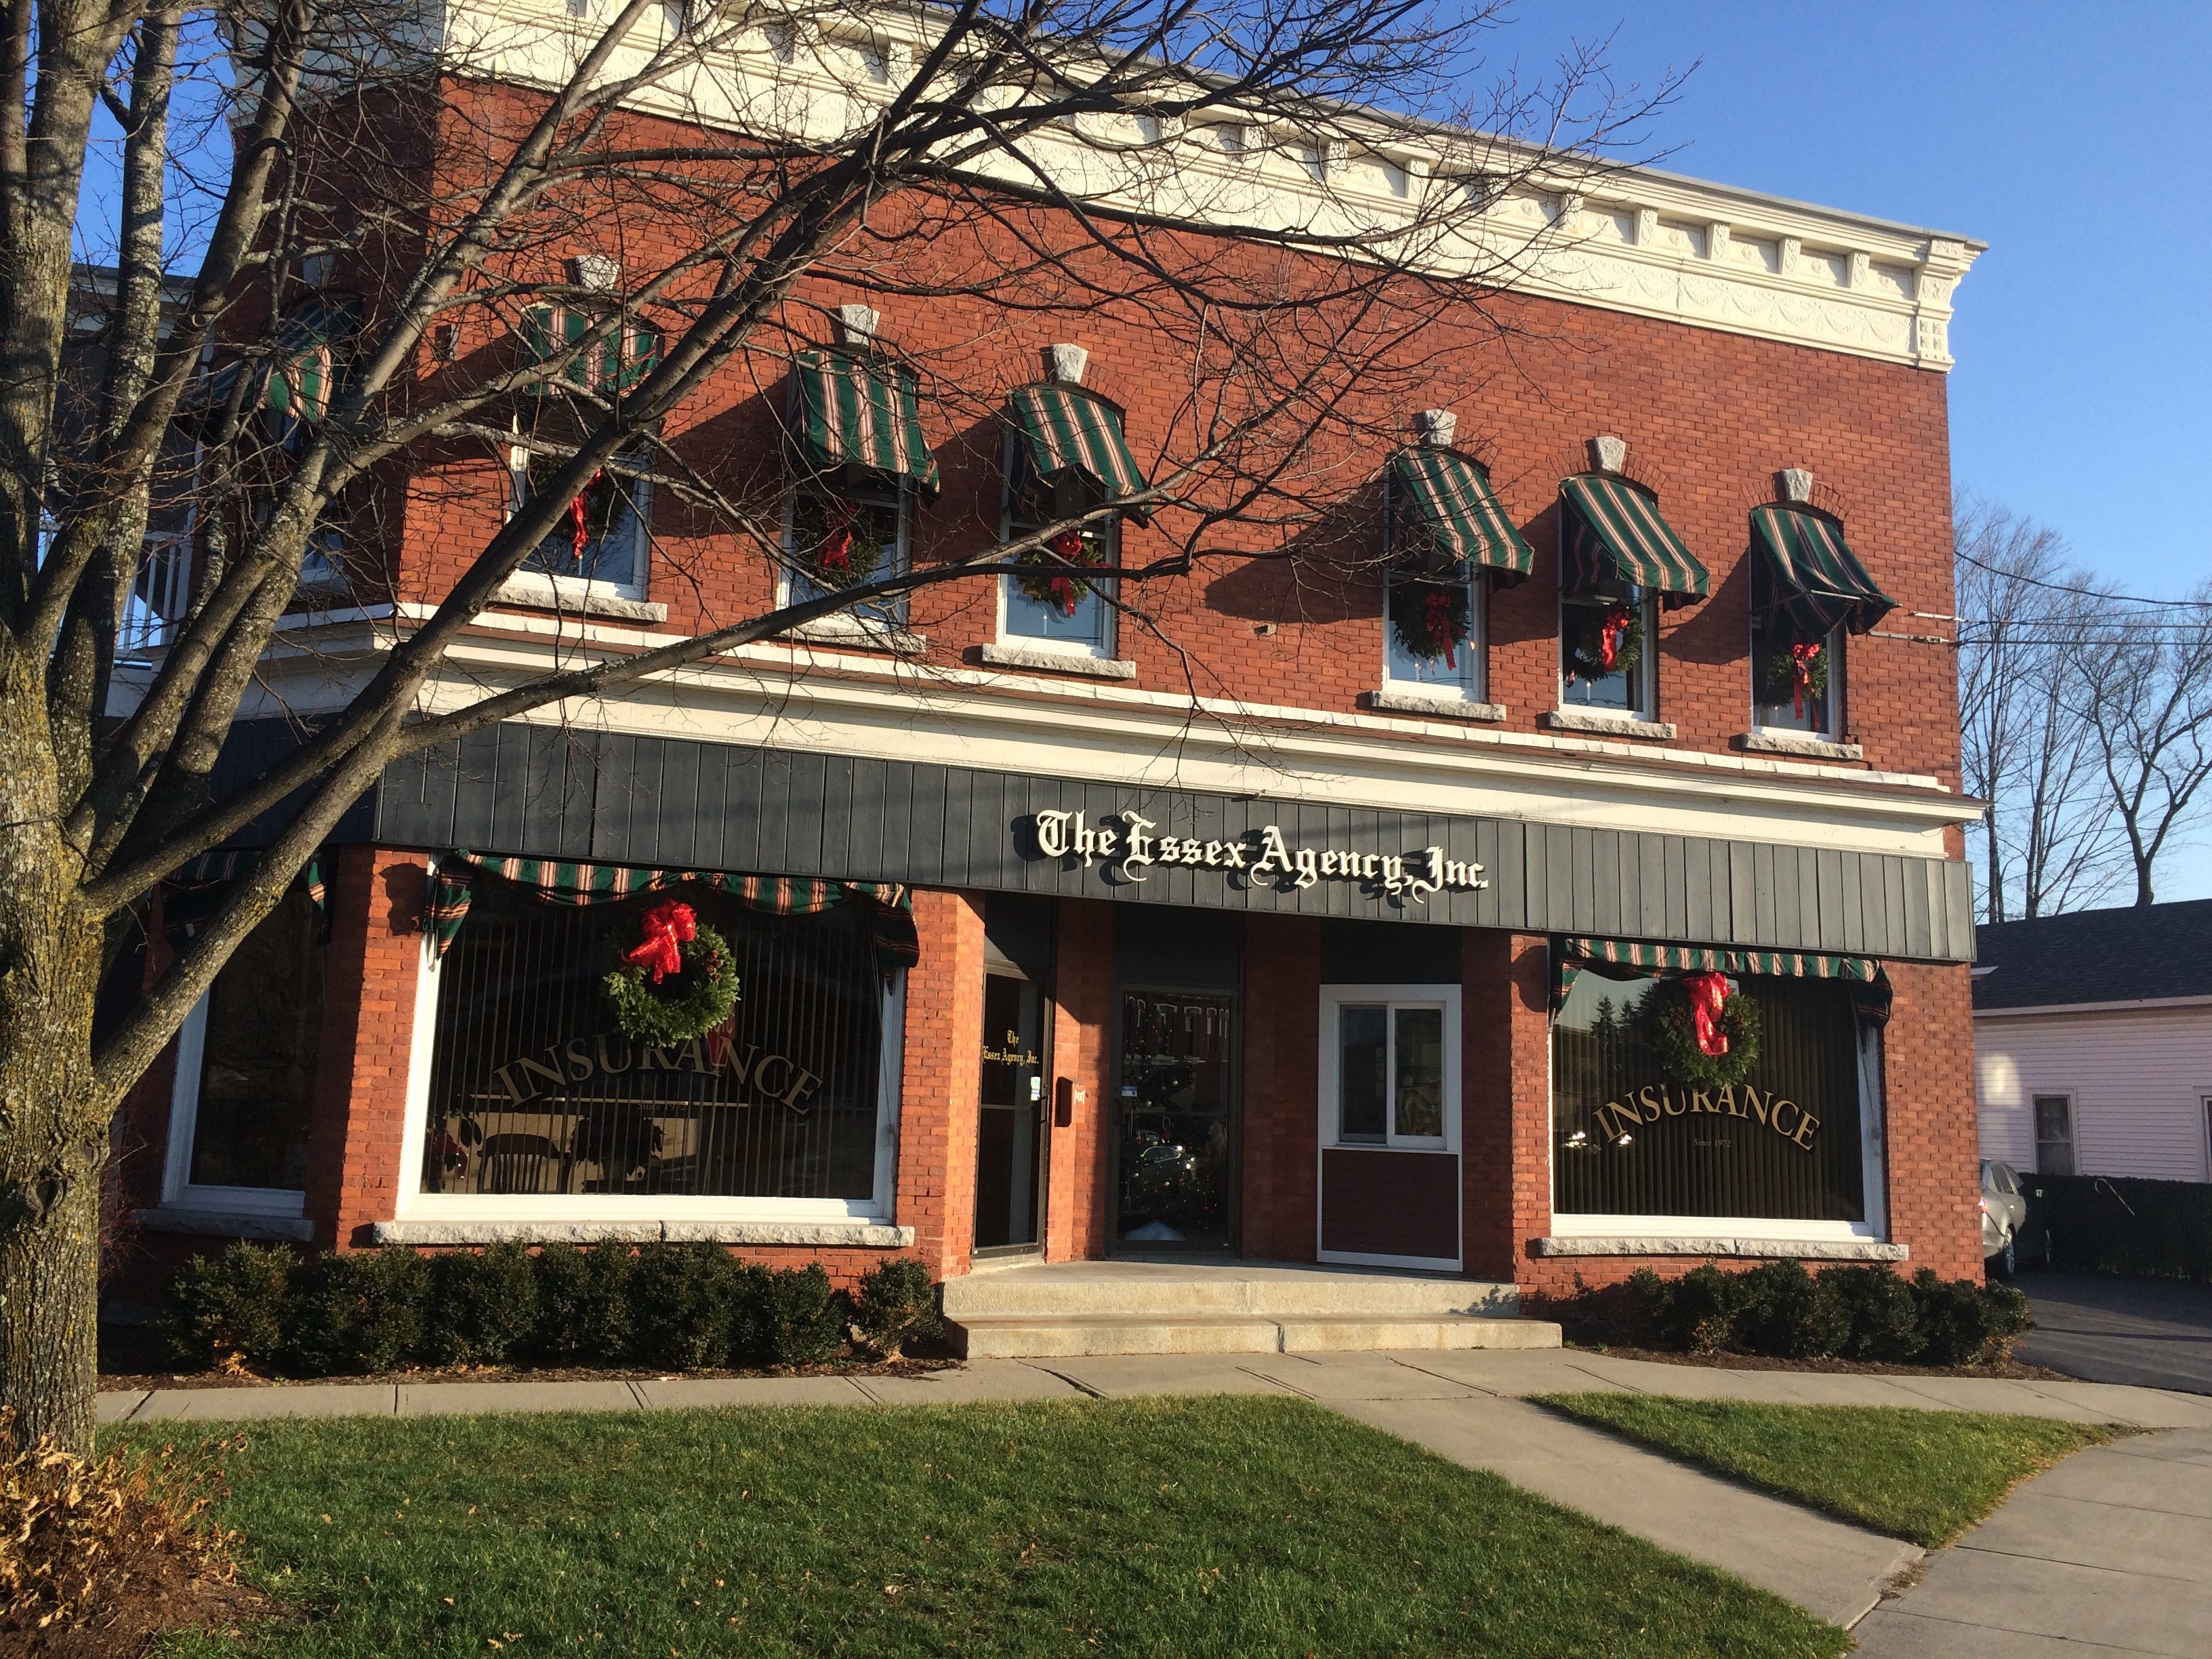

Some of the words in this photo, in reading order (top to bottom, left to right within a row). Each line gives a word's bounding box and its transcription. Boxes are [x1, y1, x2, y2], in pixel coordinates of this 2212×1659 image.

[1038, 810, 1115, 867] The
[1122, 811, 1248, 882] Essex
[1250, 825, 1414, 895] Agency,
[1412, 845, 1490, 904] Inc.
[1007, 1029, 1019, 1048] The
[983, 1046, 1000, 1063] Essex
[1026, 1050, 1039, 1067] Inc.
[493, 1031, 823, 1115] INSURANCE
[636, 1103, 661, 1111] Since
[1593, 1083, 1821, 1151] INSURANCE
[1694, 1138, 1712, 1147] Since
[1715, 1139, 1731, 1147] 1972
